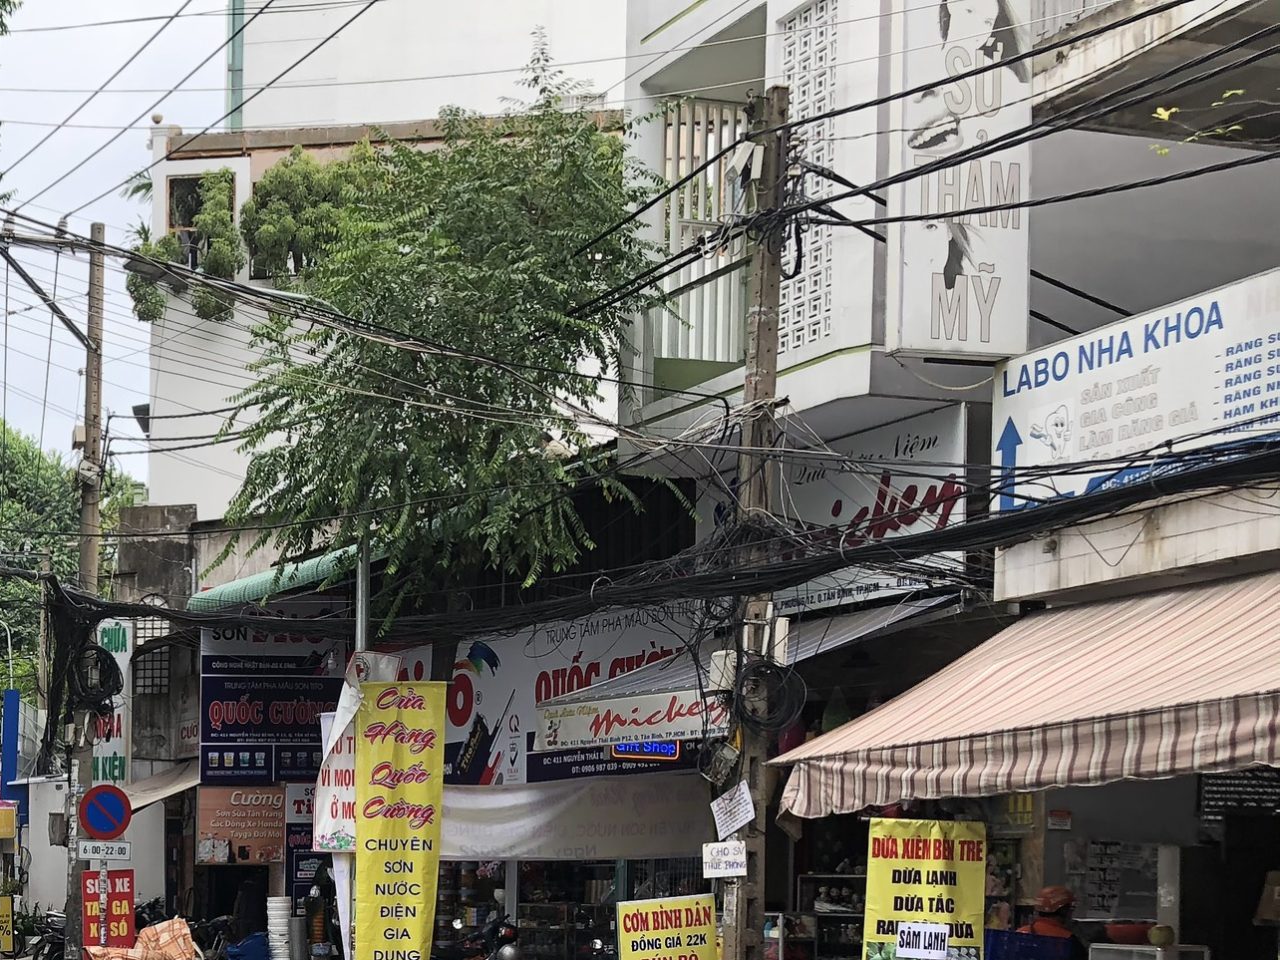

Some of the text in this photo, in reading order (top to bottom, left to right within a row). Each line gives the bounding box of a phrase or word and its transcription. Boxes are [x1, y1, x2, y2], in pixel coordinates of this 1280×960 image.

[930, 262, 1001, 343] MỸ
[1003, 301, 1224, 398] LABO NHA KHOA
[101, 621, 129, 654] CHỮA
[208, 694, 265, 730] QUỐC
[363, 719, 438, 755] Hàng
[321, 767, 332, 788] VÌ
[369, 761, 432, 791] Quốc
[230, 791, 284, 809] Cường
[363, 795, 436, 830] Cường
[365, 836, 433, 851] CHUYÊN
[958, 840, 984, 862] TRE
[384, 860, 414, 874] SƠN
[891, 867, 957, 888] DỪA LẠNH
[115, 878, 131, 893] XE
[375, 882, 421, 896] NƯỚC
[112, 899, 131, 916] GA
[380, 903, 417, 920] ĐIỆN
[893, 894, 924, 912] DỪA
[110, 917, 129, 938] SỐ
[623, 901, 712, 933] CƠM BÌNH DÂN
[383, 927, 411, 941] GIA
[631, 932, 707, 952] ĐỒNG GIÁ 22K
[898, 926, 947, 954] SÂM LẠNH
